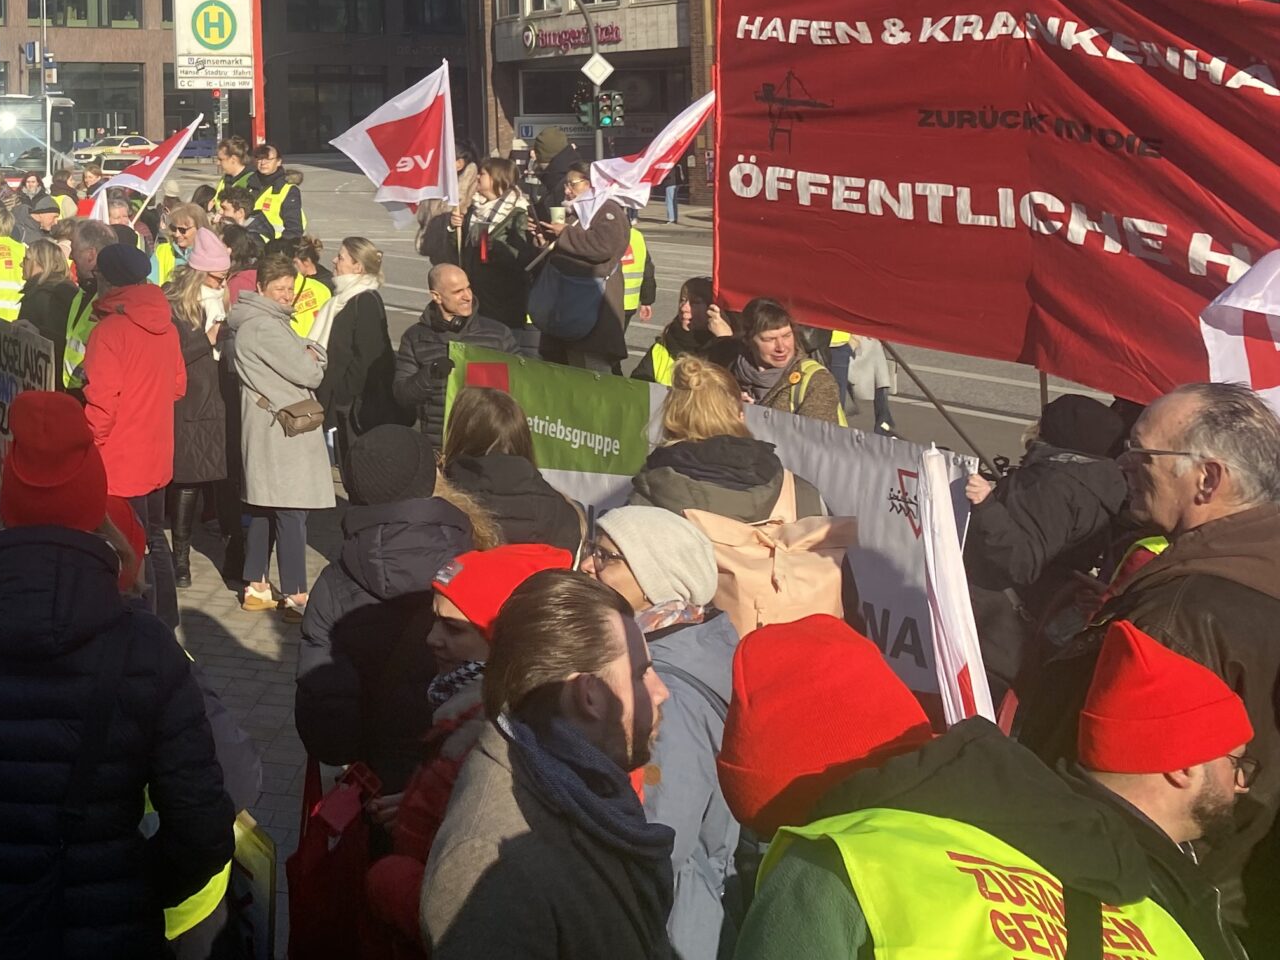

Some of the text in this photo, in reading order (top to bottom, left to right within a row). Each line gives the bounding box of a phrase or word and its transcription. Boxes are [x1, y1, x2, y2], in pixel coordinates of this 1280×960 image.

[736, 15, 873, 45] HAFEN
[881, 18, 911, 45] &
[917, 105, 1049, 133] ZURÜCK
[1054, 117, 1094, 144] IN
[728, 154, 1172, 265] ÖFFENTLICHE
